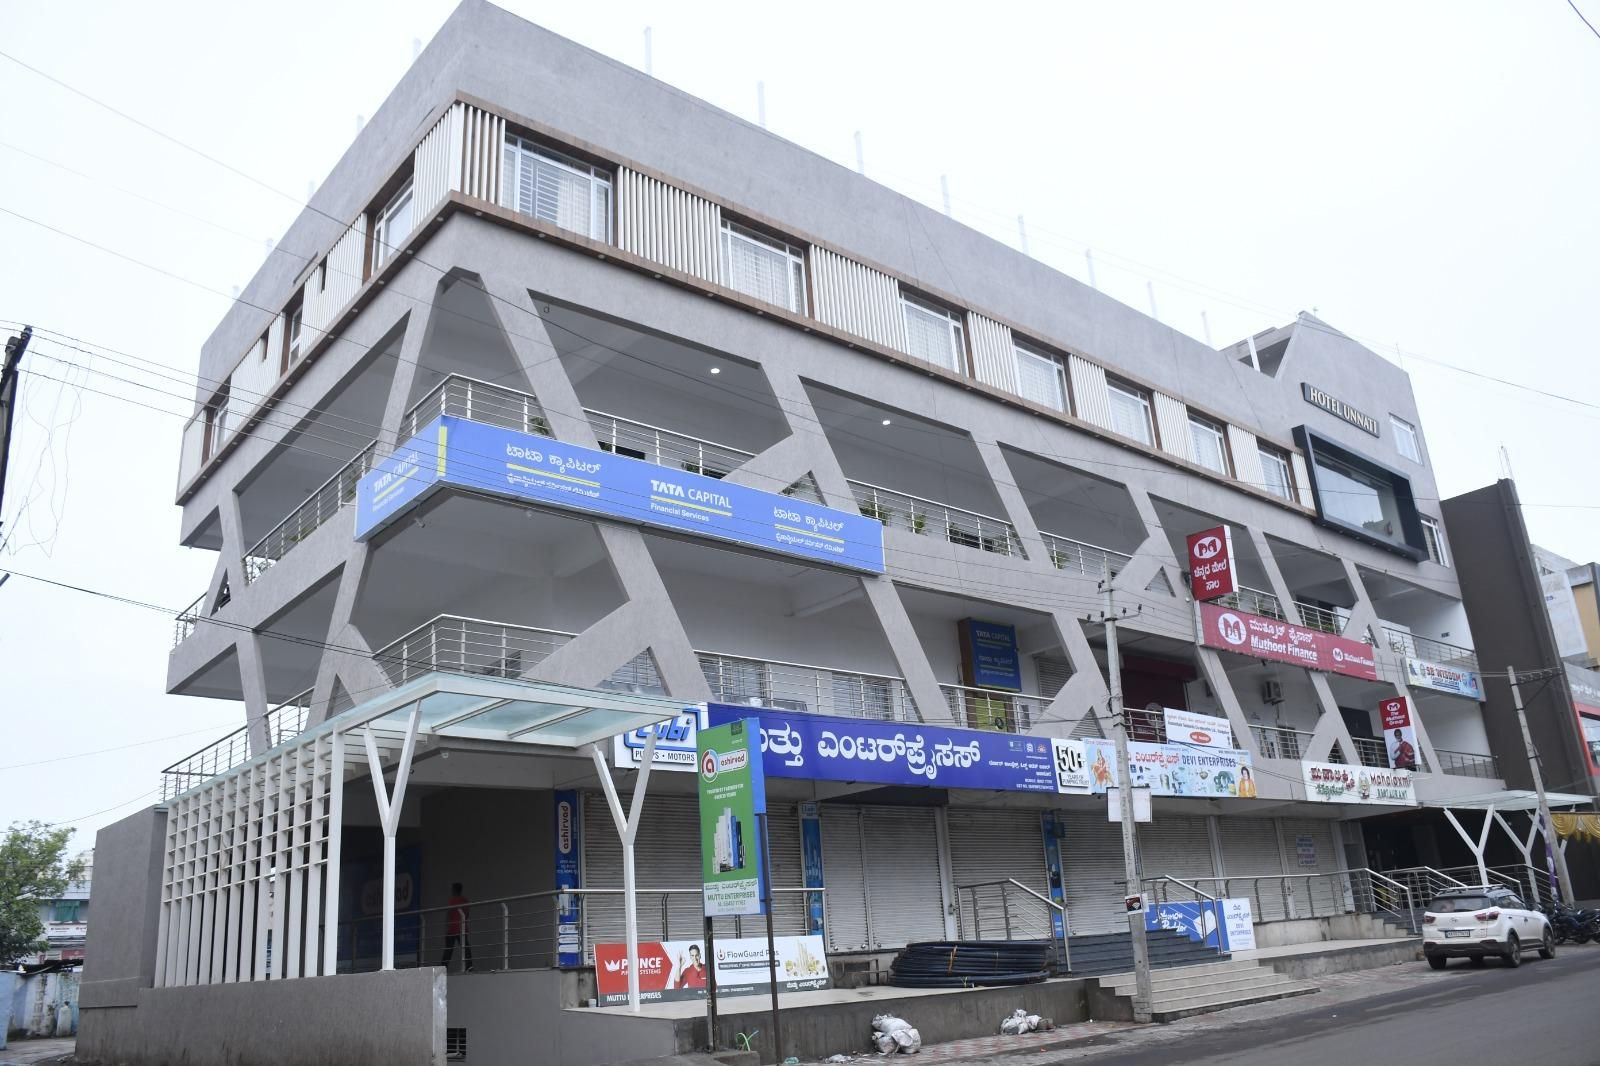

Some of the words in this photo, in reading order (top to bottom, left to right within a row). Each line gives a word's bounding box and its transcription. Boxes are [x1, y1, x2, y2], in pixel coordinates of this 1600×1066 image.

[1310, 387, 1342, 416] HOTEL
[1343, 404, 1378, 434] UNNATI
[506, 443, 543, 462] ಟಾಟಾ
[549, 454, 601, 474] ಕ್ಯಾಪಿಟಲ್
[374, 472, 392, 493] TATA
[650, 480, 685, 498] TATA
[687, 488, 732, 509] CAPITAL
[650, 502, 681, 515] Financial
[681, 509, 710, 522] Services
[774, 507, 801, 522] ಟಾಟಾ
[1206, 580, 1220, 591] ಸಾಲ
[976, 630, 991, 639] TATA
[1250, 634, 1287, 654] Muthoot
[1287, 643, 1318, 661] Finance
[635, 750, 660, 760] PUS
[667, 752, 695, 762] MOTORS
[720, 754, 745, 767] ashirvad
[1181, 755, 1196, 765] DEVI
[1198, 756, 1237, 768] ENTERPRISES
[560, 805, 569, 850] ashirvad
[727, 949, 764, 960] FlowGuard
[765, 948, 780, 958] Ps
[621, 956, 661, 970] PNCE
[606, 993, 627, 1002] MUTTU
[627, 991, 662, 1001] ERPRISES
